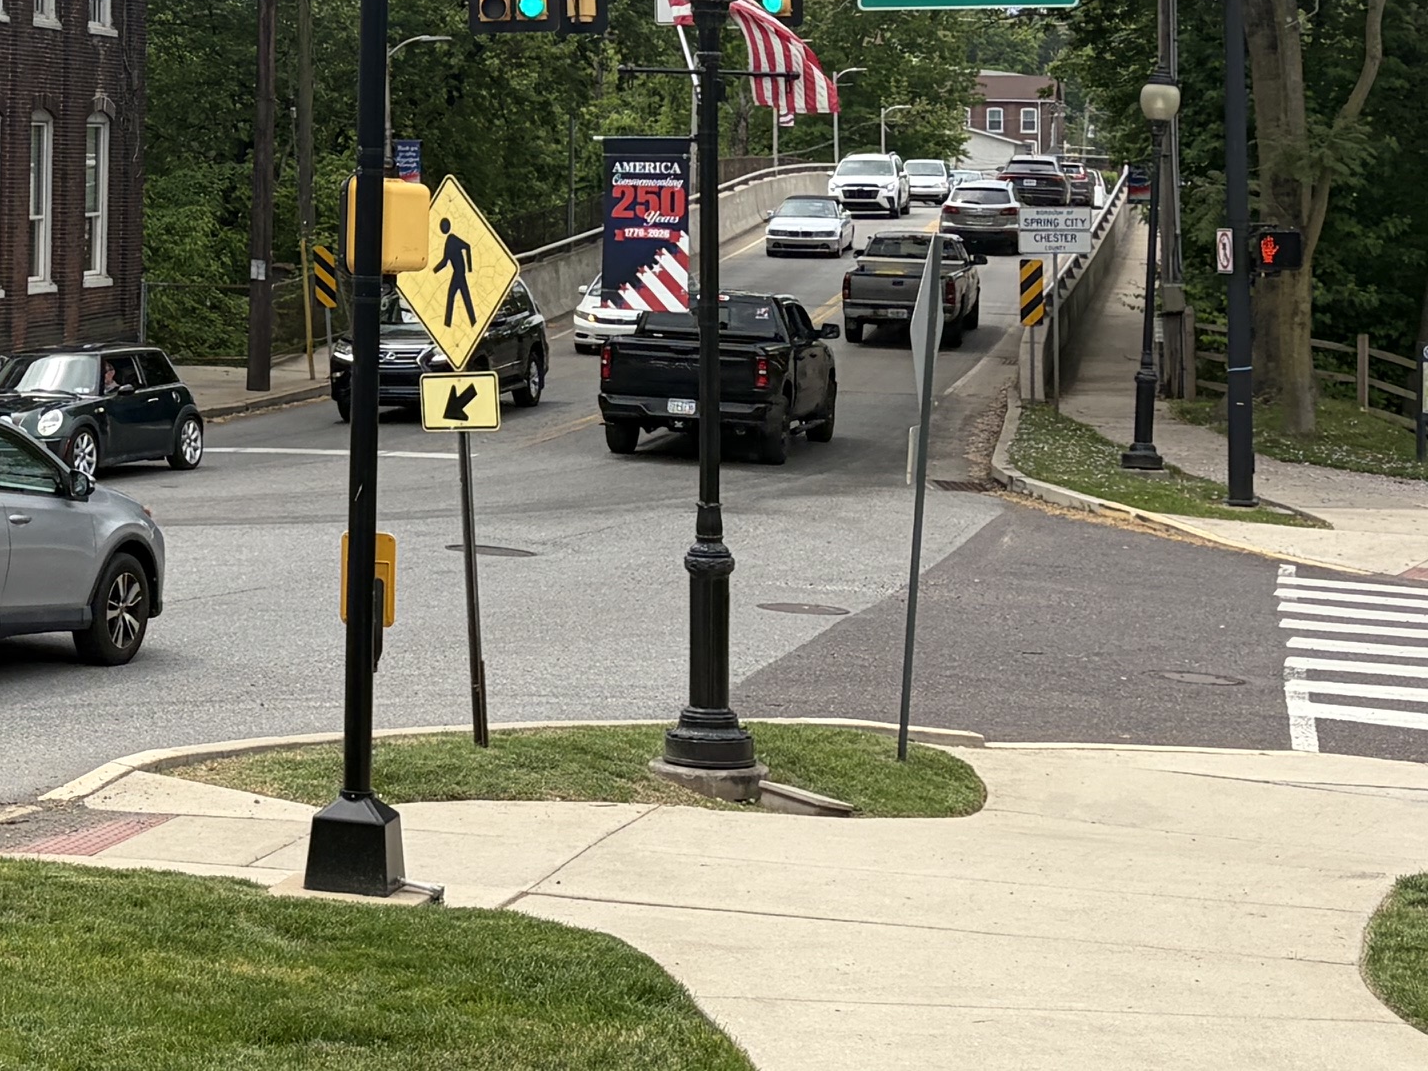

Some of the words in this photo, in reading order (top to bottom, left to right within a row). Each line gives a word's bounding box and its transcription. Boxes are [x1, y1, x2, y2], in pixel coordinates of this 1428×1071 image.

[612, 161, 681, 174] AMERICA
[612, 173, 683, 190] Commemorating
[611, 185, 685, 218] 250
[643, 210, 679, 226] Years
[1024, 217, 1059, 228] SPRING
[1064, 217, 1087, 228] CITY
[624, 228, 670, 240] 1776-2026
[1033, 232, 1077, 243] CHESTER
